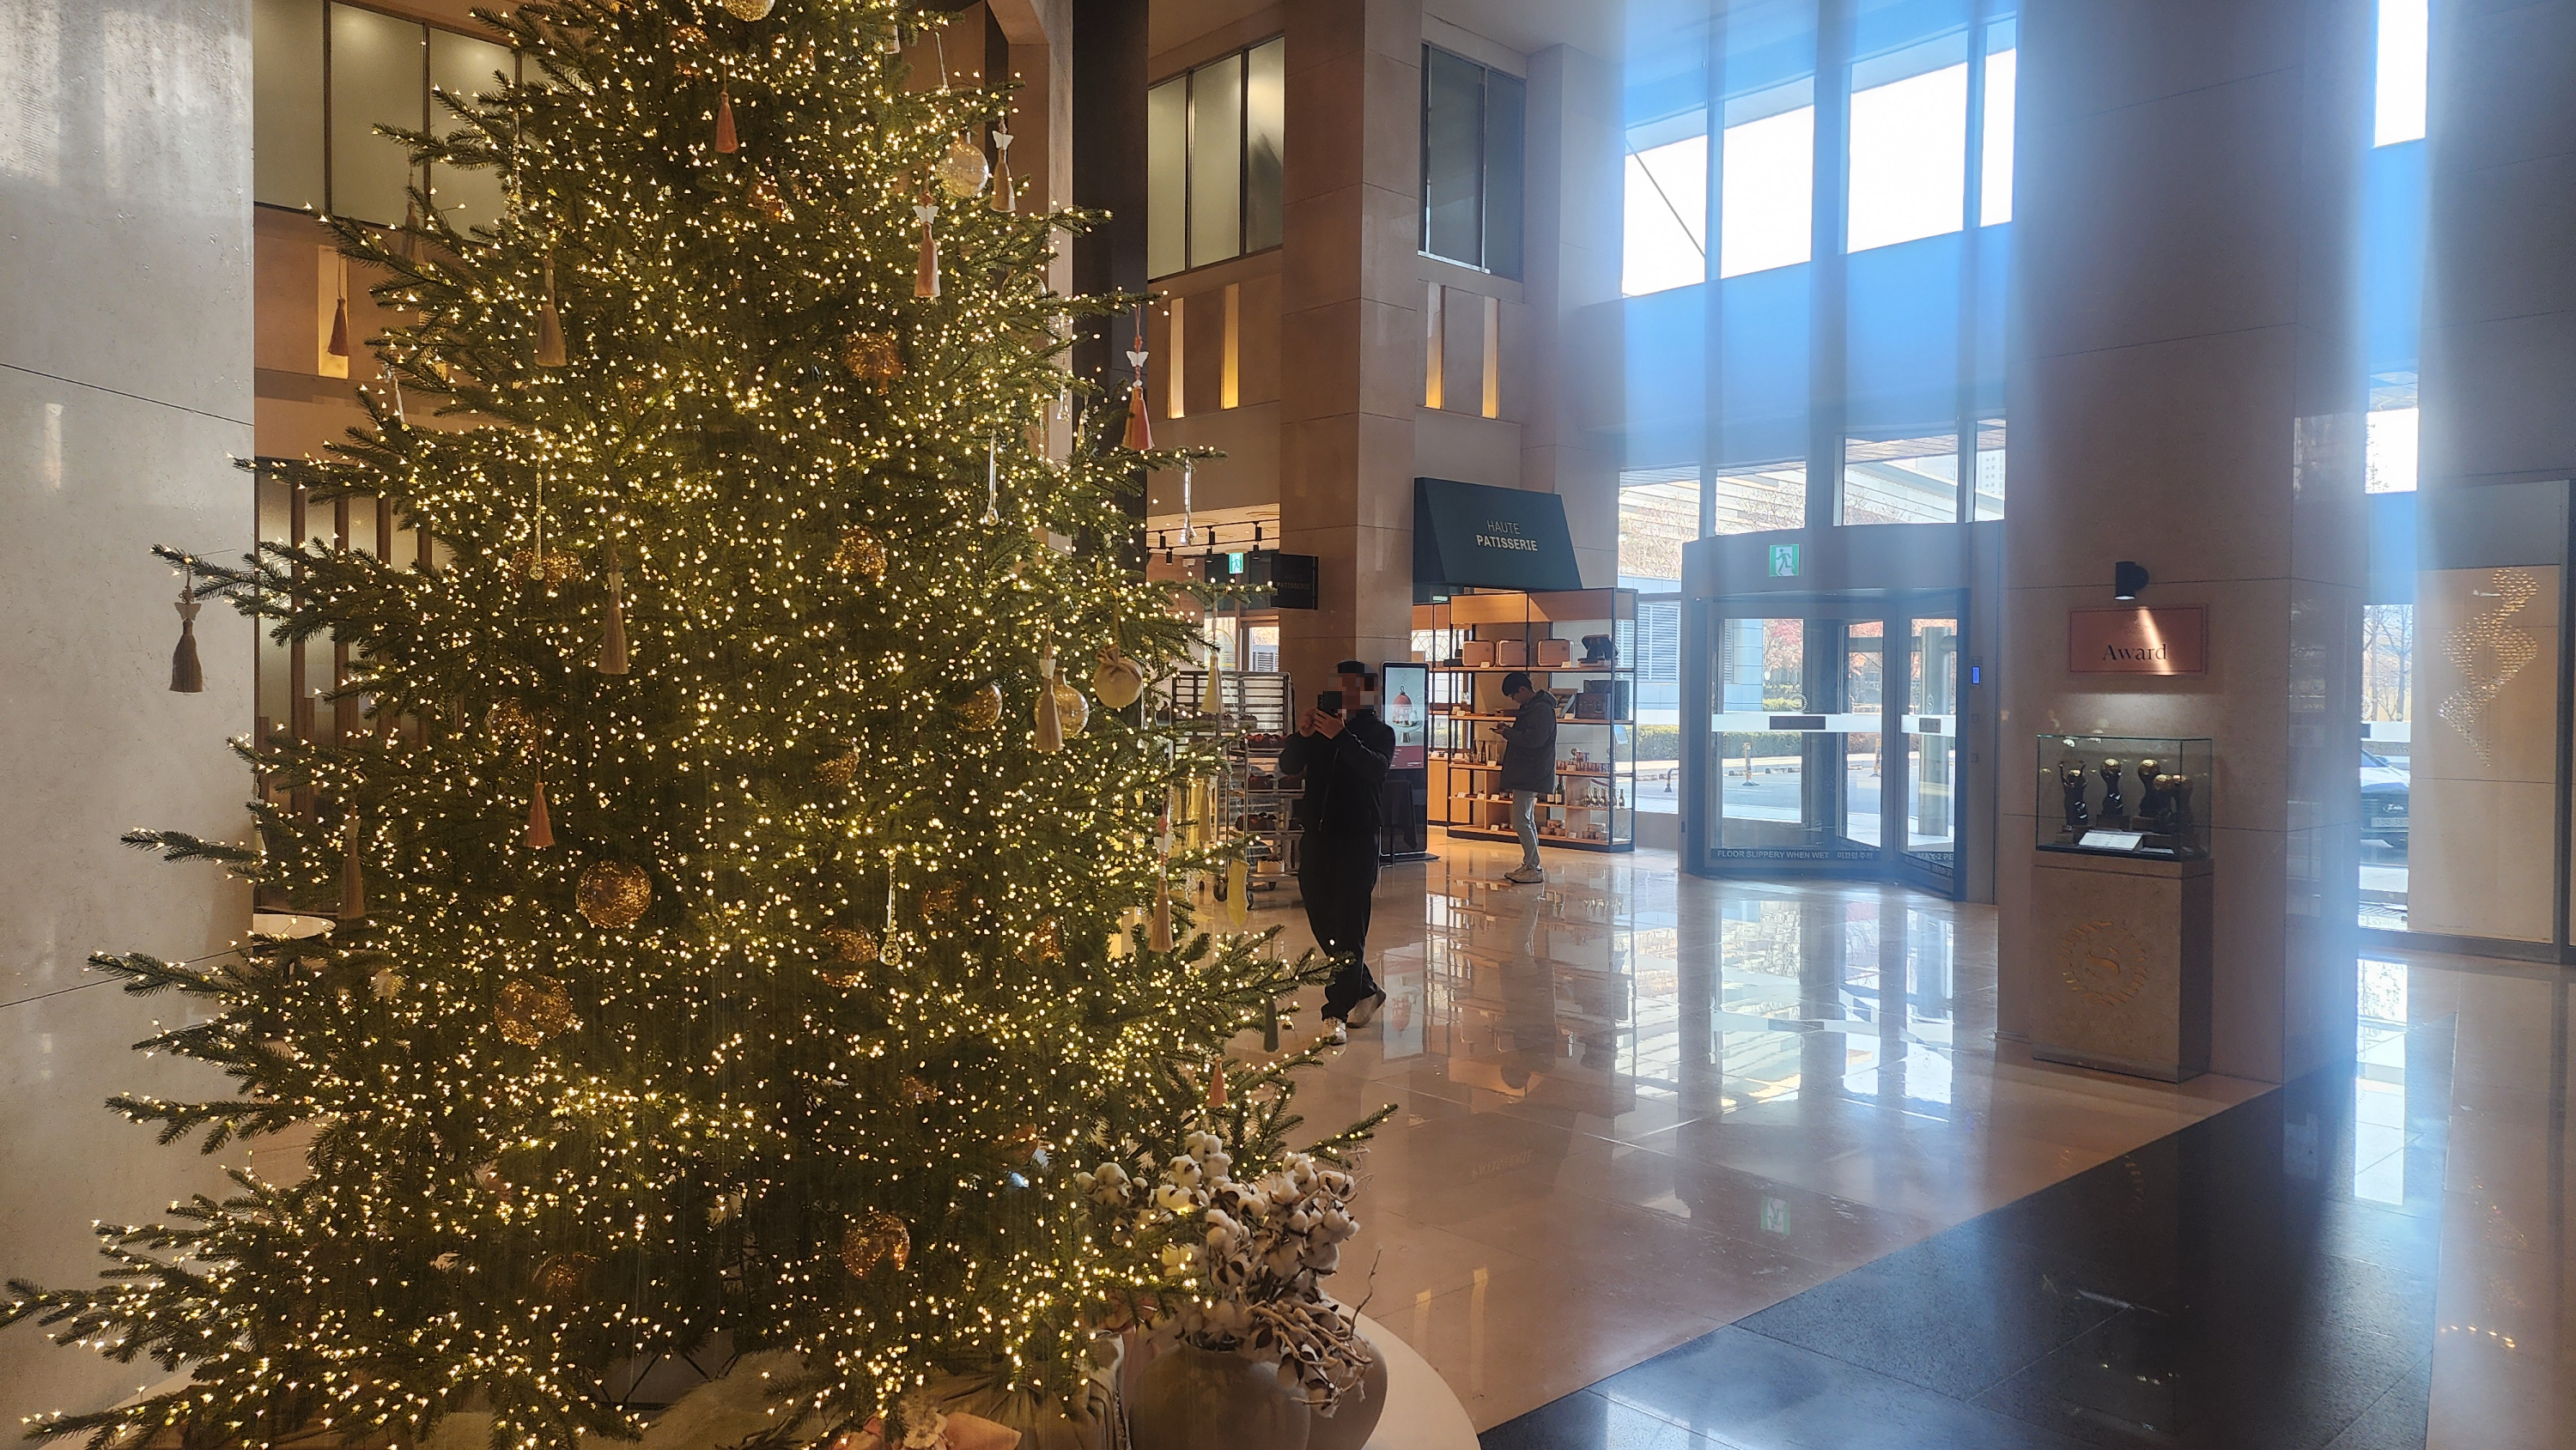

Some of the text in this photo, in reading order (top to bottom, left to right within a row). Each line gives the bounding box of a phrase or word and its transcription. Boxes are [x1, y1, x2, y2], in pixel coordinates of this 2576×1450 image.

[1486, 519, 1521, 535] HAUTE
[1476, 534, 1539, 551] PATISSERIE
[2103, 644, 2168, 661] Award
[1746, 850, 1784, 858] SLIPPERY
